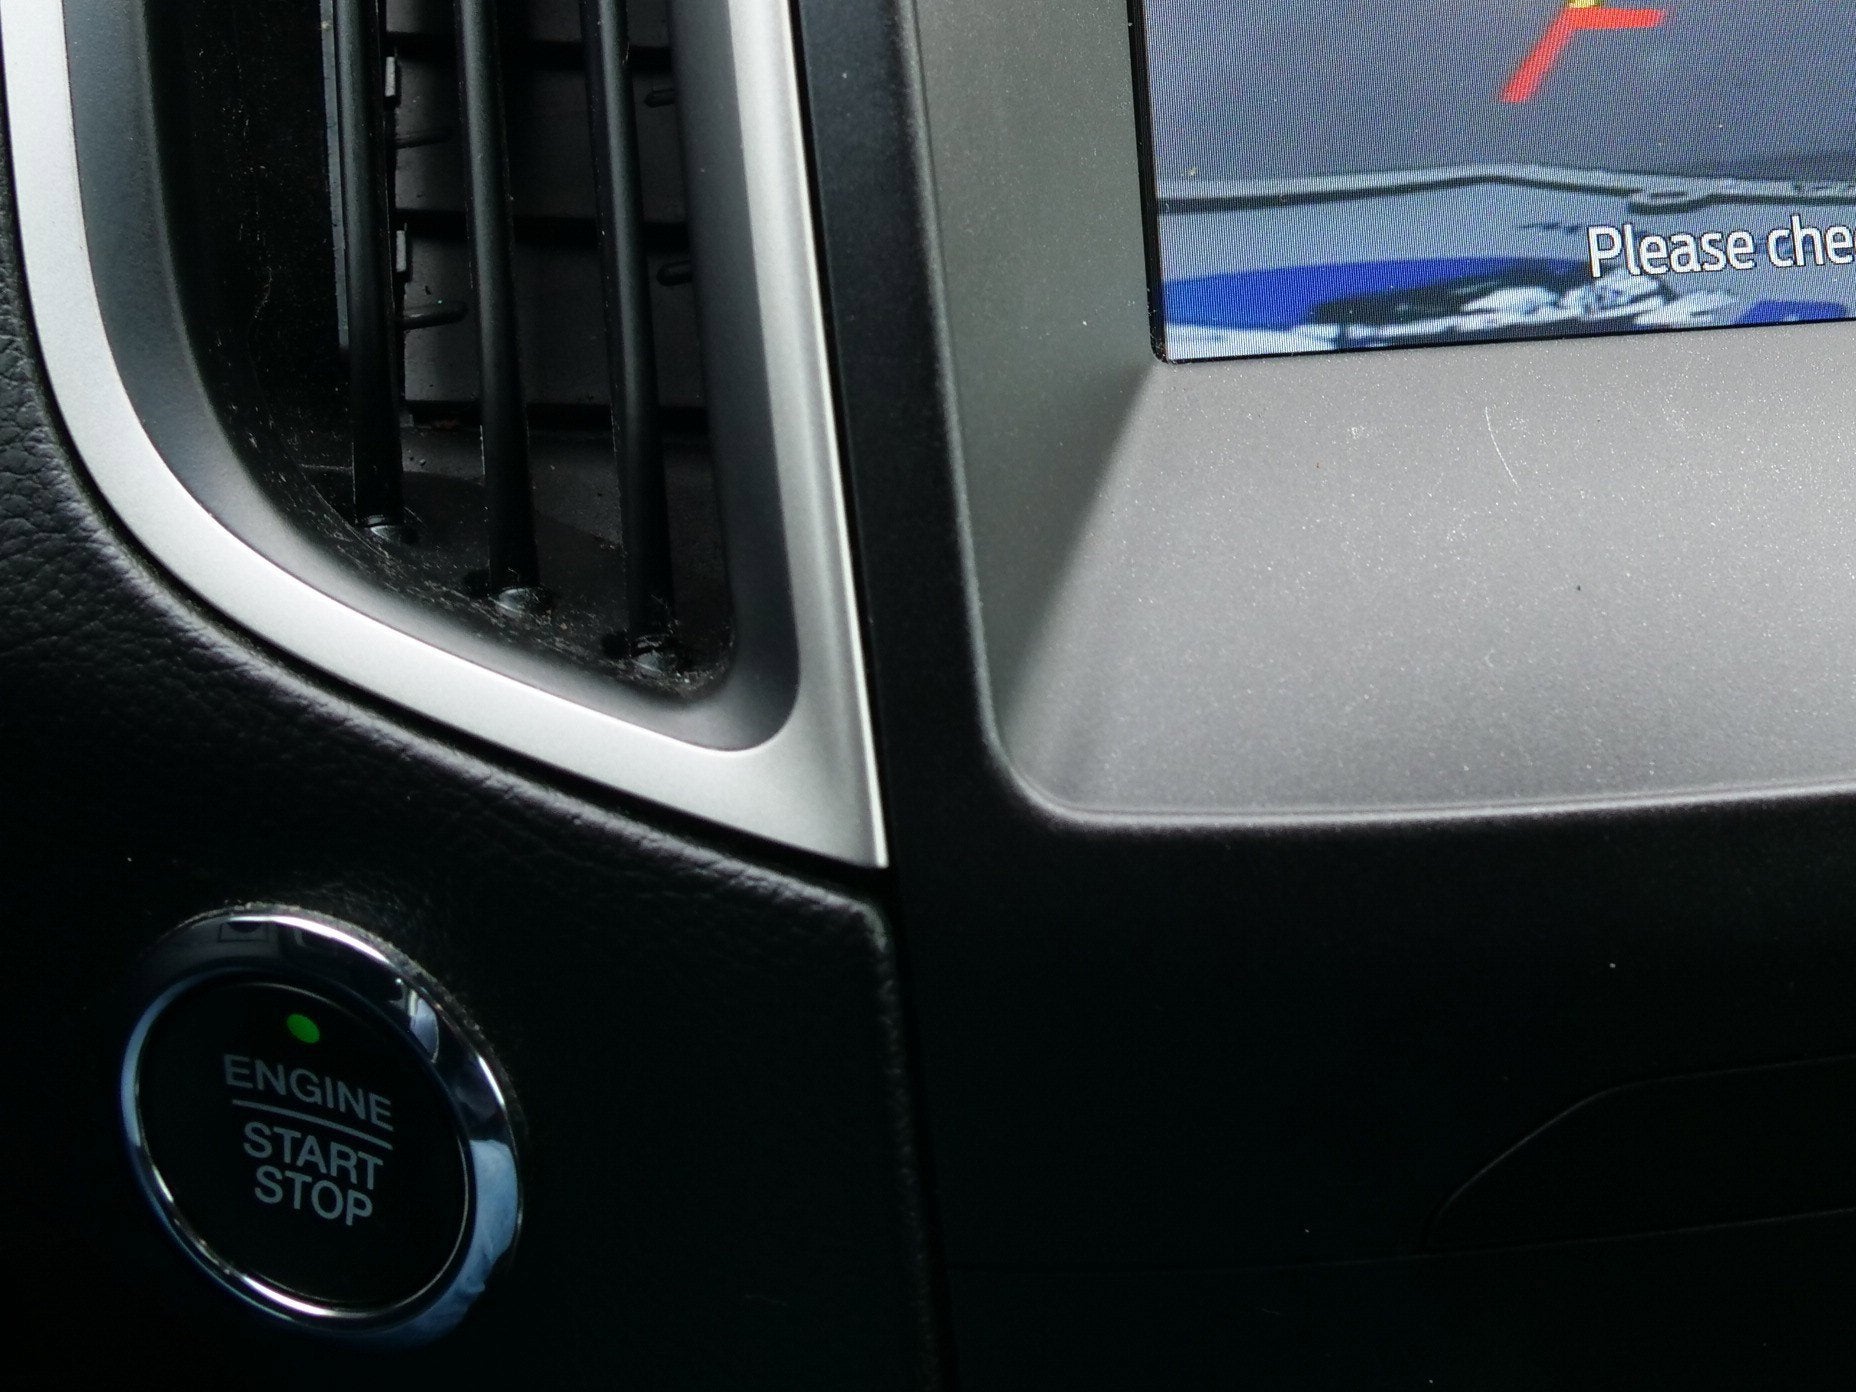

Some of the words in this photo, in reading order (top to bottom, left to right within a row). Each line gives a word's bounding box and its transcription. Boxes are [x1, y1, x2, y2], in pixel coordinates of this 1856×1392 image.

[1586, 222, 1756, 280] Please
[222, 1053, 395, 1133] ENGINE
[242, 1120, 385, 1191] START
[253, 1163, 375, 1227] STOP
